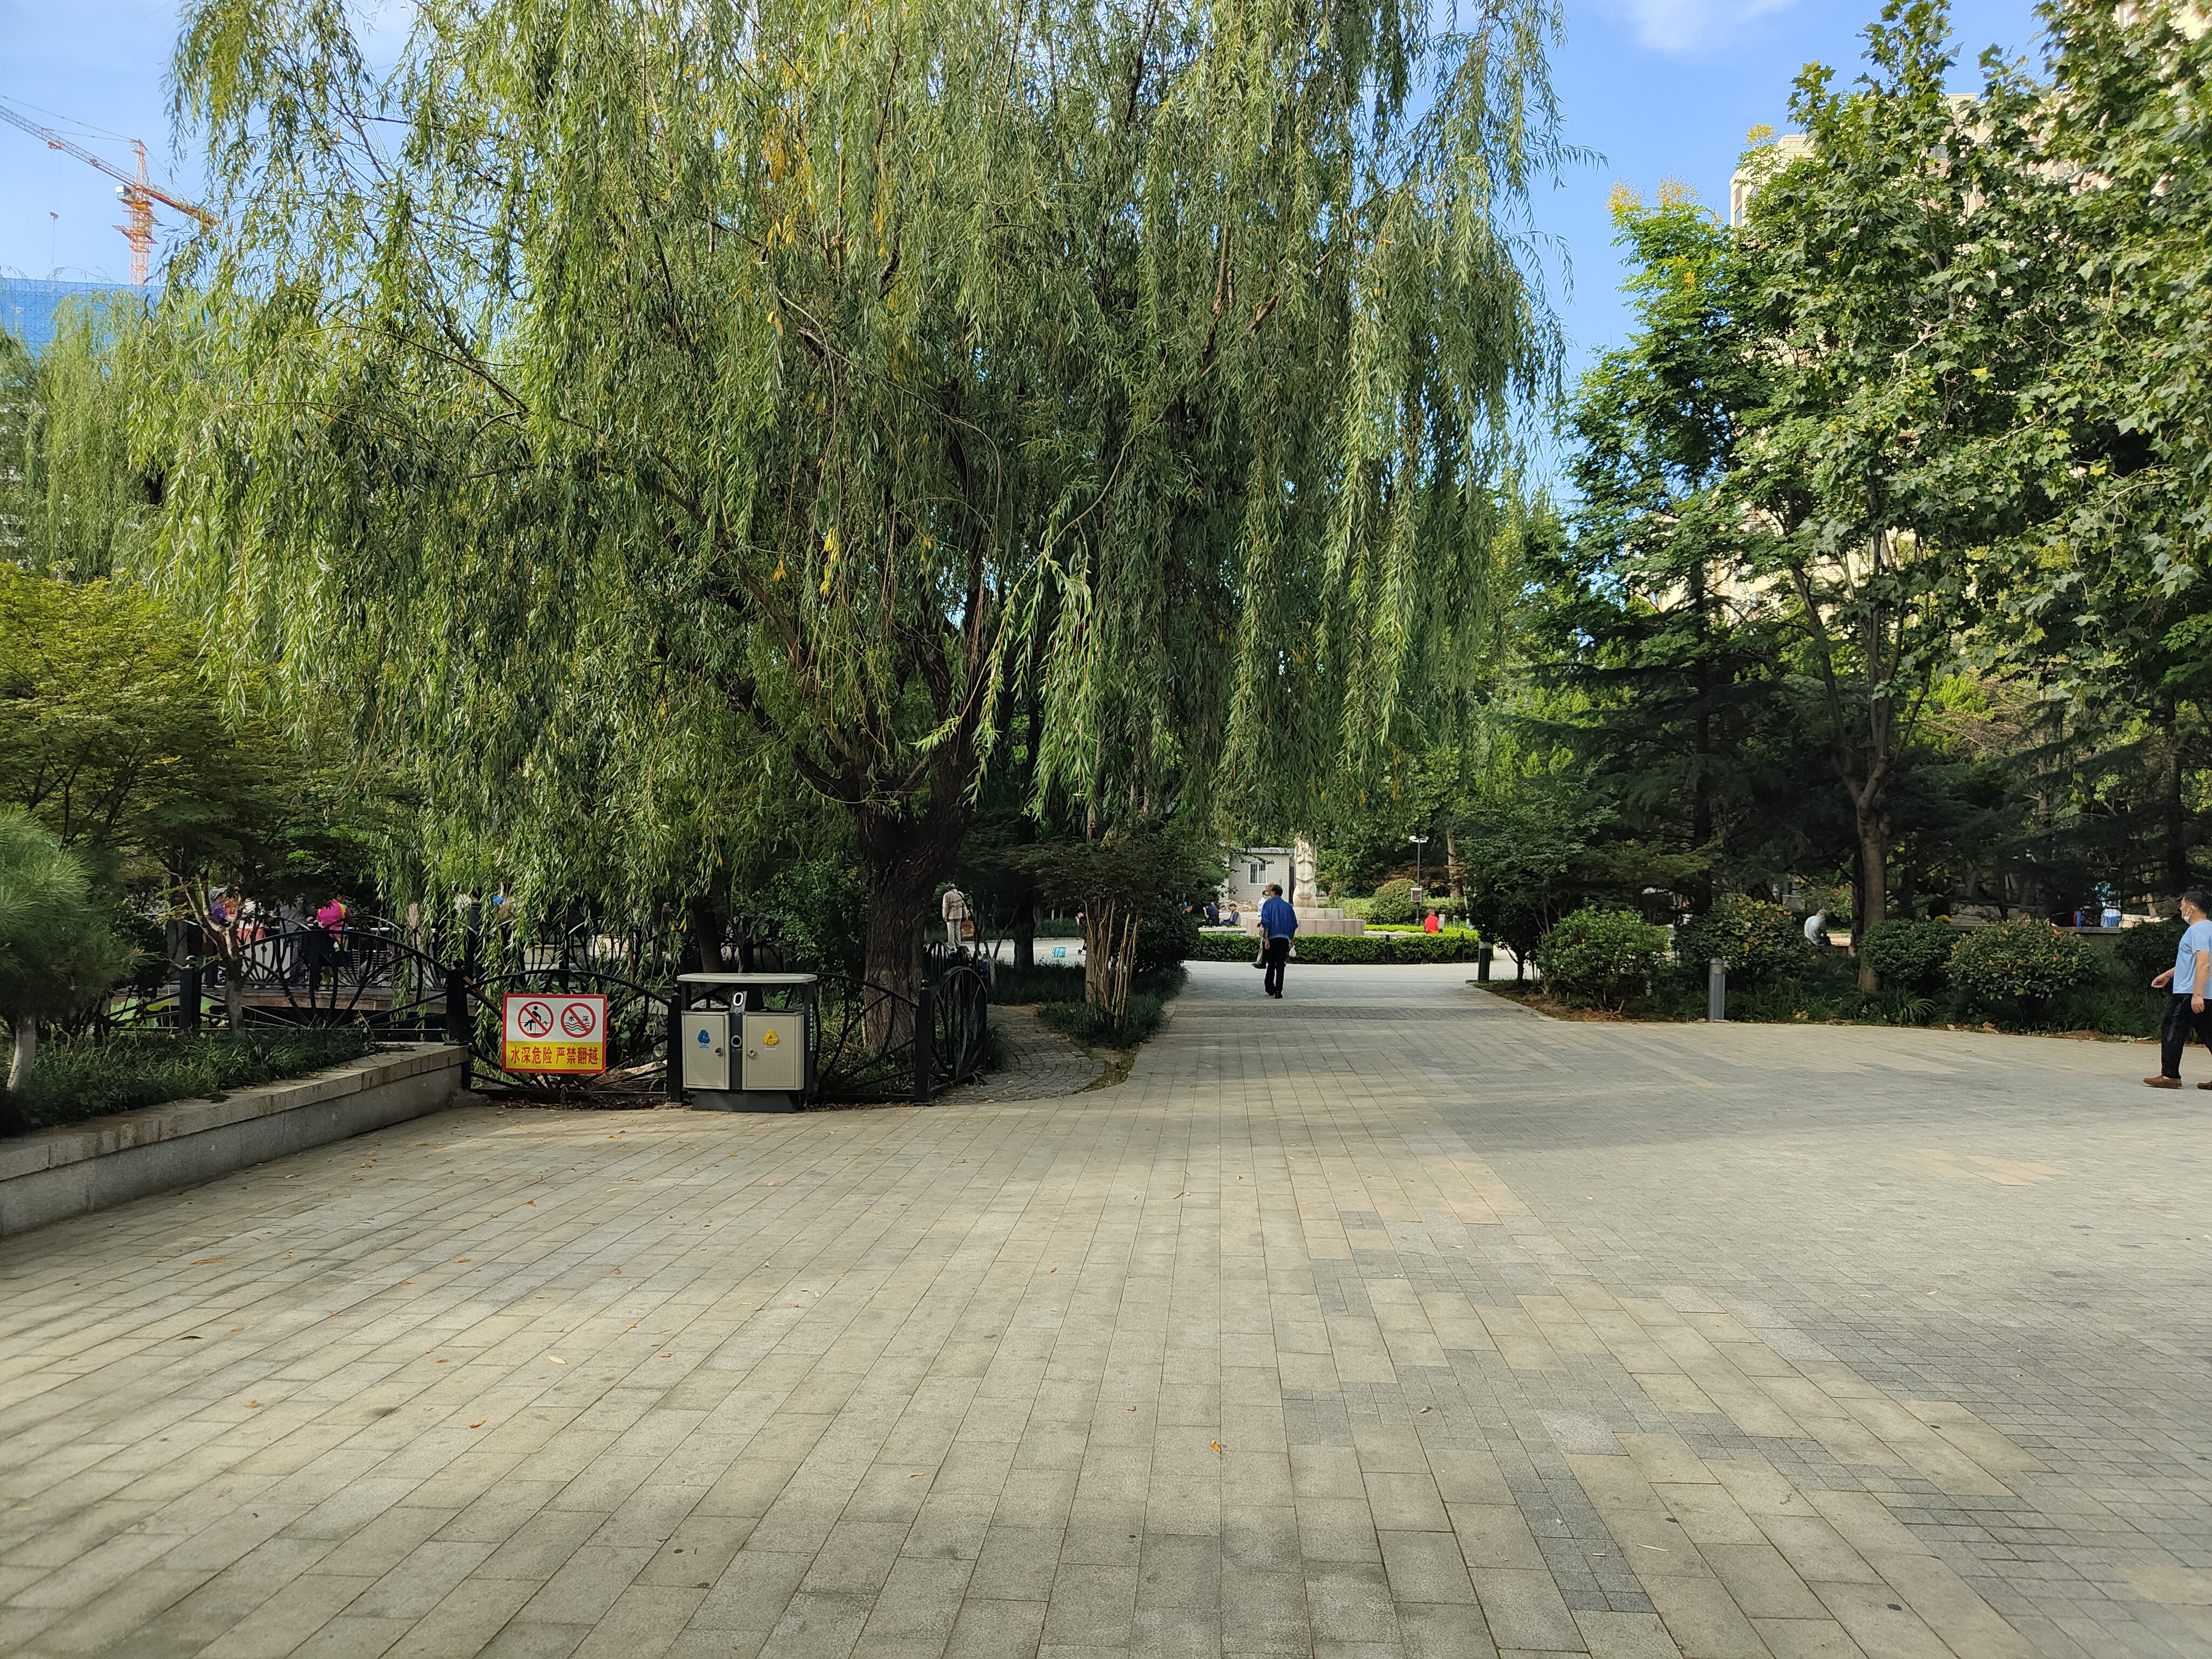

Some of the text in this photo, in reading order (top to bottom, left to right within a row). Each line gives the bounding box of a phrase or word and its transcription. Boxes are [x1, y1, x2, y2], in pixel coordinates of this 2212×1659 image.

[511, 1046, 598, 1065] 水深危险 严禁翻越
